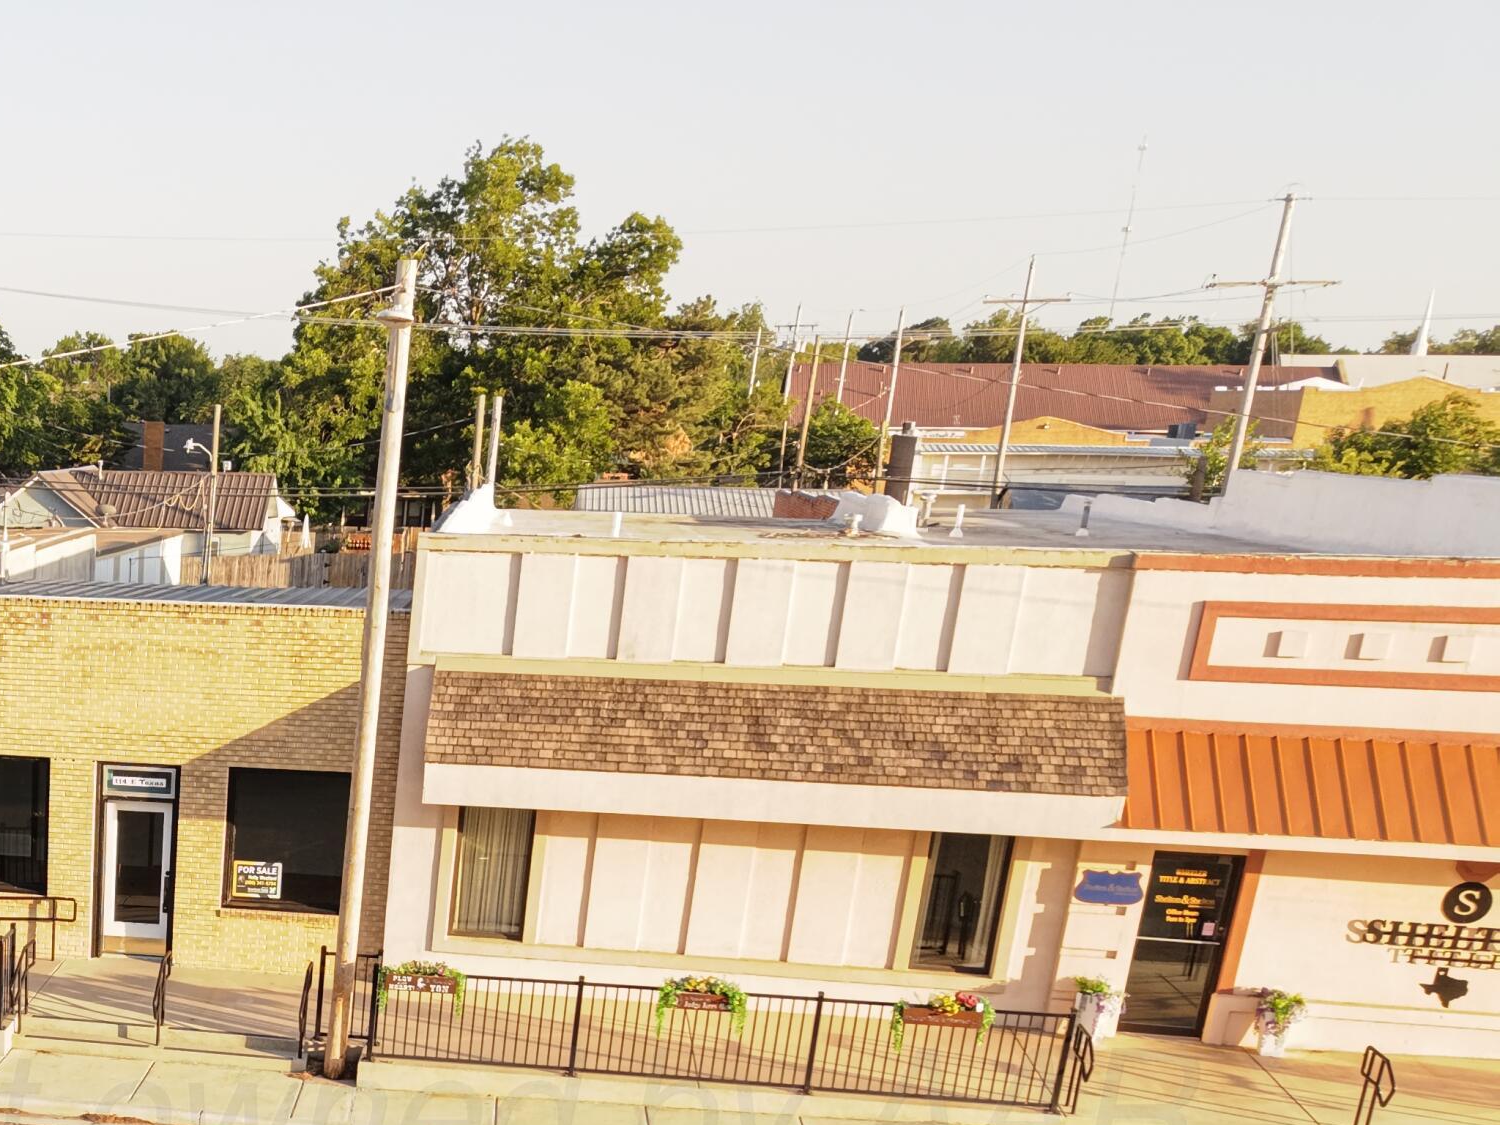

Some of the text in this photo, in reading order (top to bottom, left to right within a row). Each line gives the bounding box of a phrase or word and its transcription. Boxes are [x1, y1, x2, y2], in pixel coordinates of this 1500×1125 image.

[237, 865, 278, 875] FOR SALE
[1159, 875, 1178, 883] TITLE
[1453, 890, 1481, 916] S
